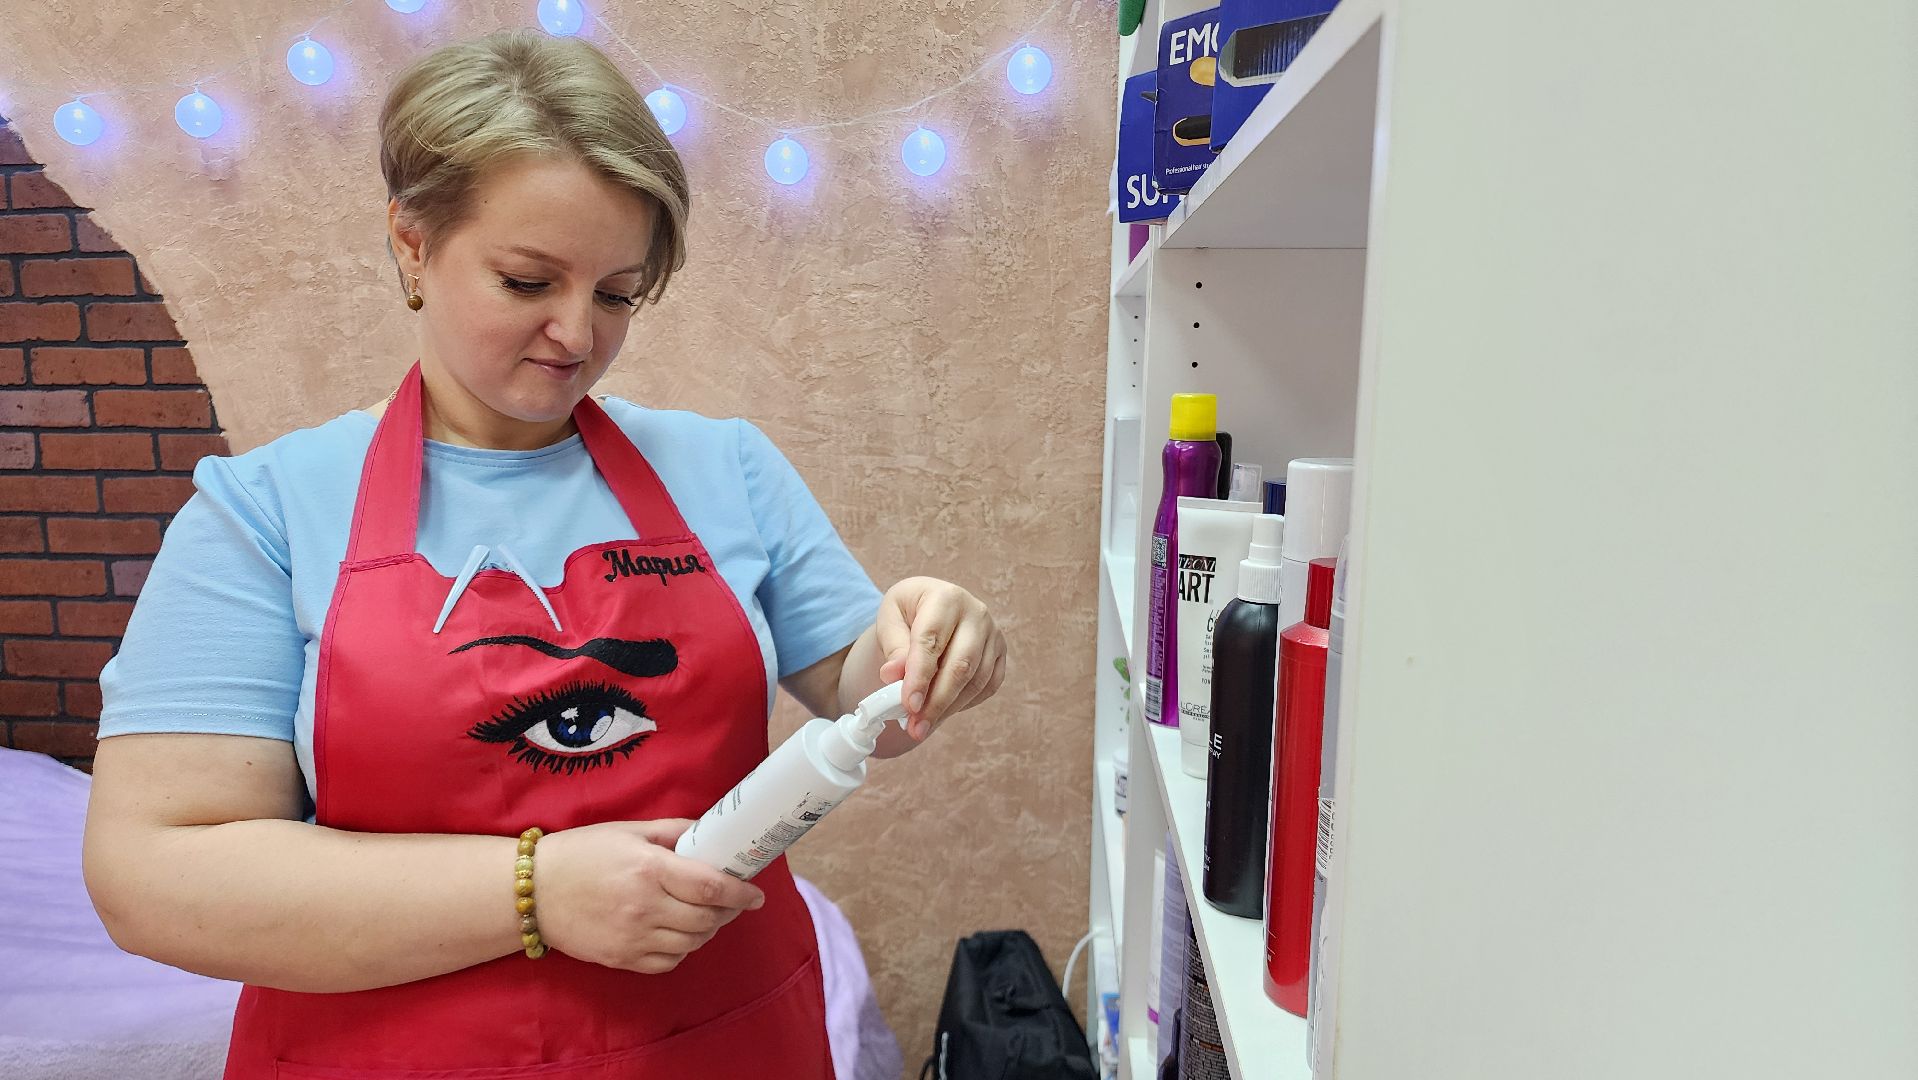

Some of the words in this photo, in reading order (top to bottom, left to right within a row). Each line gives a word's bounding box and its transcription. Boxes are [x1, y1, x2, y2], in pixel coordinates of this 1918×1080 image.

[1126, 174, 1185, 209] SU
[602, 549, 706, 586] Мария
[1179, 571, 1215, 603] ART
[1181, 701, 1210, 714] L'ORÉ
